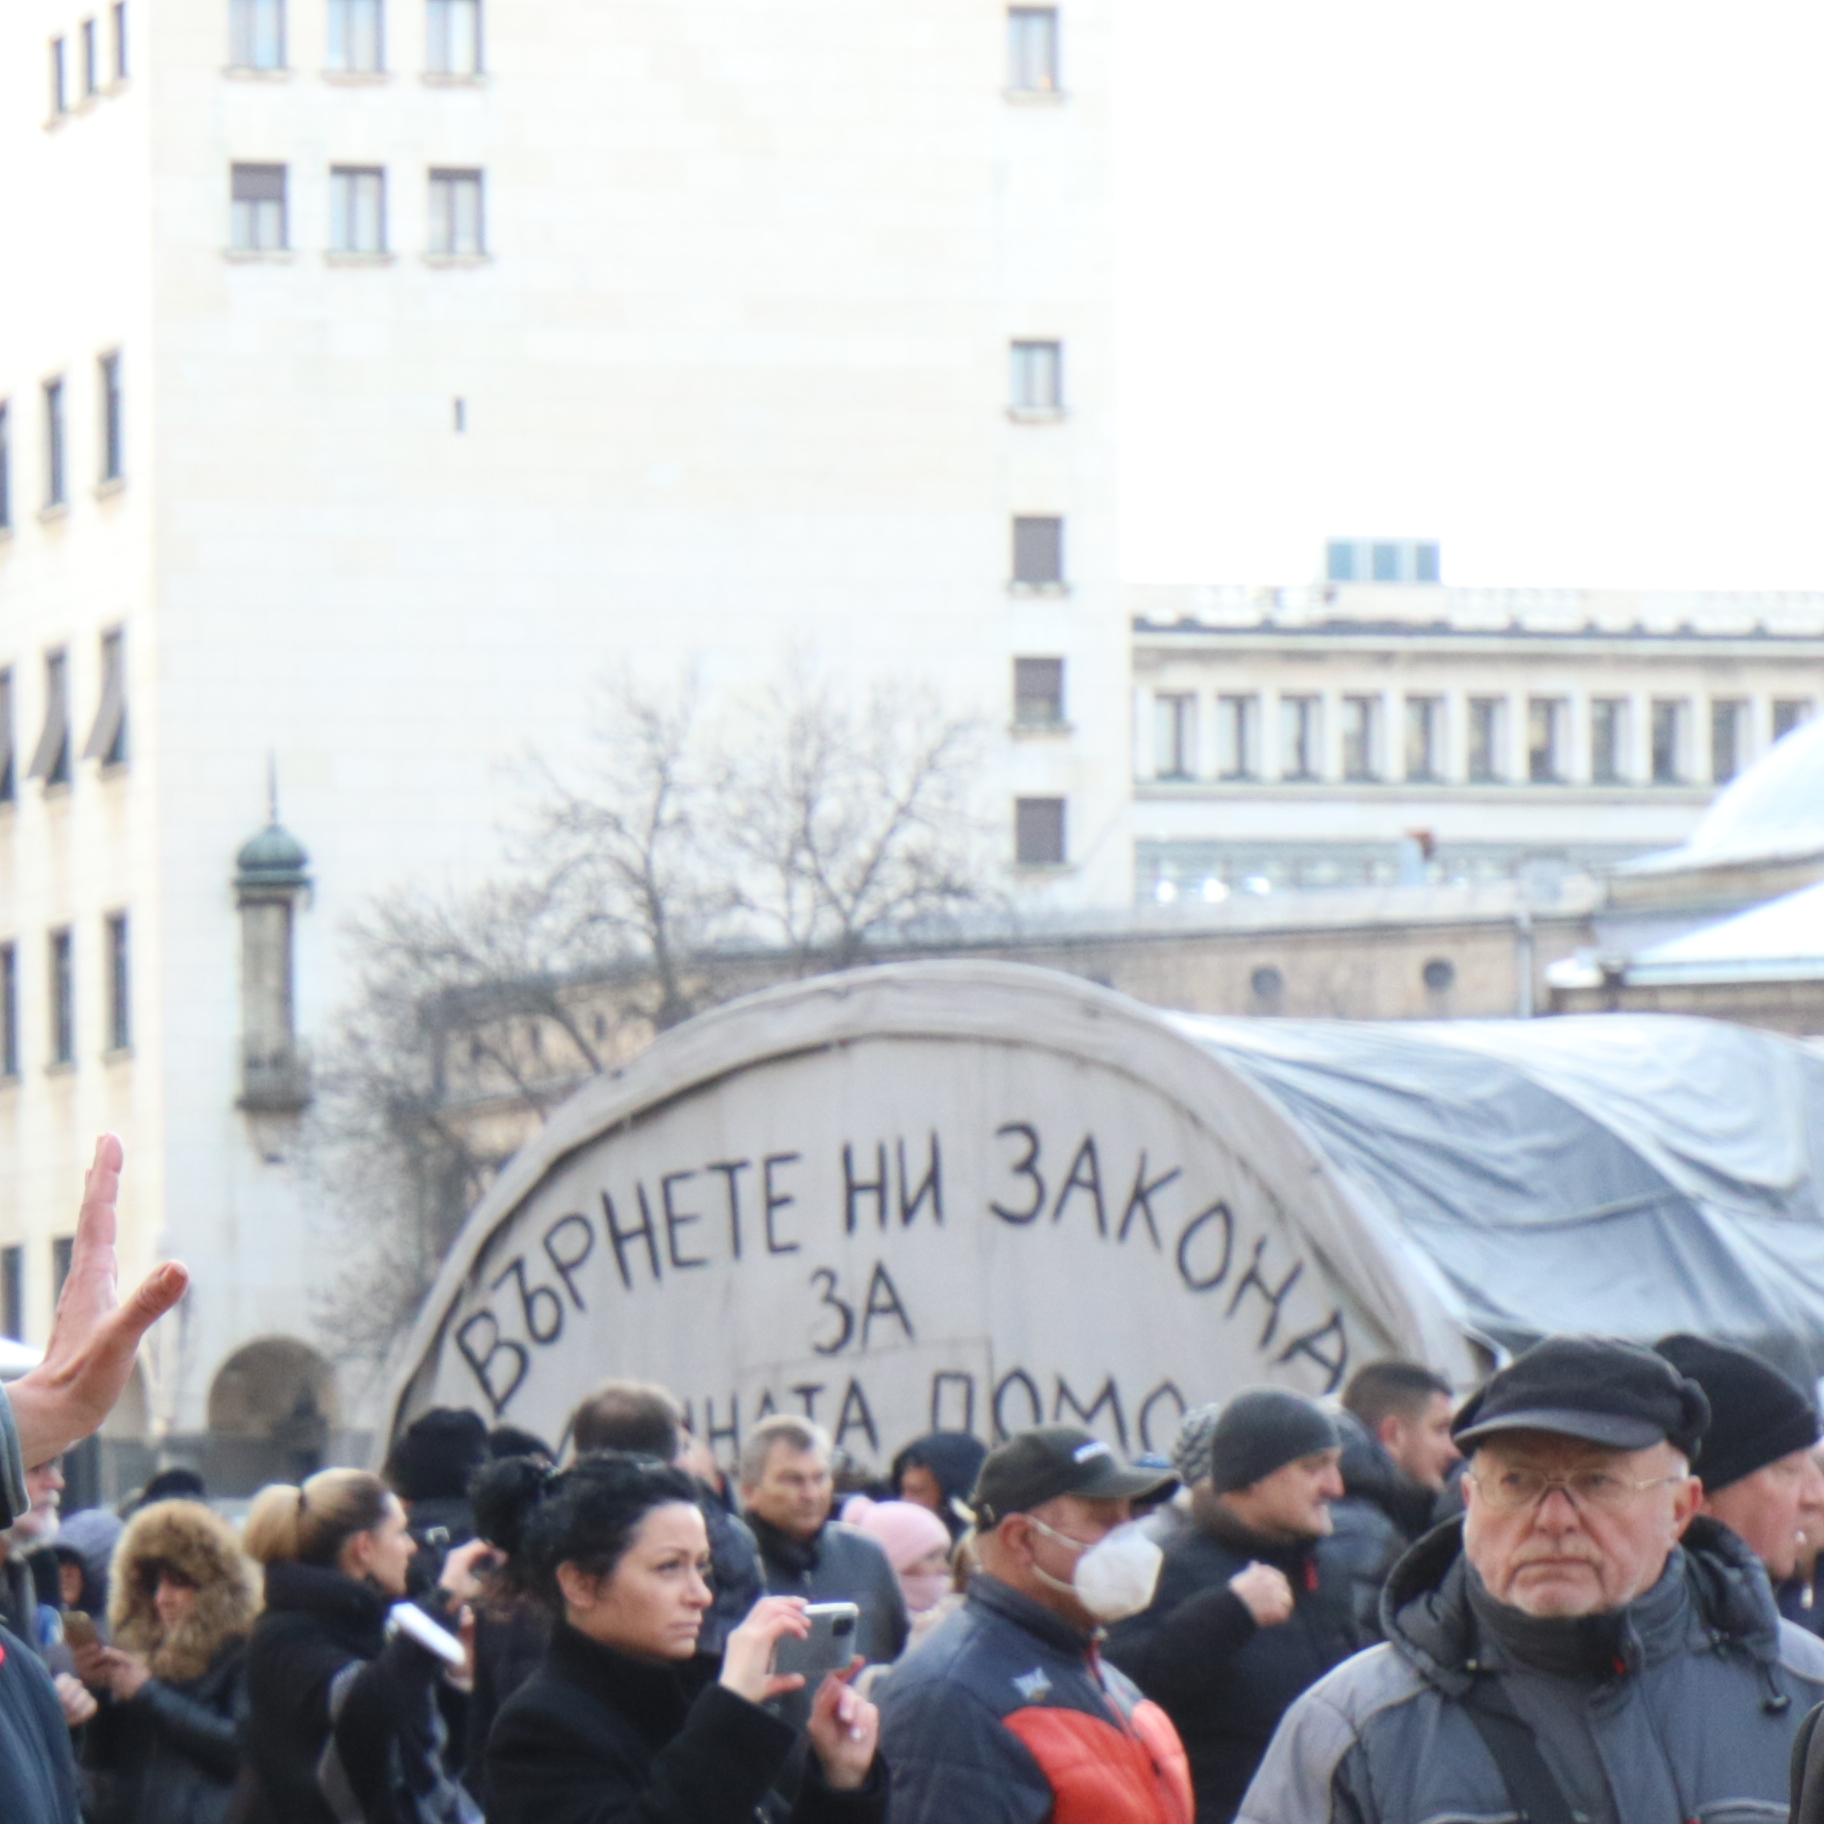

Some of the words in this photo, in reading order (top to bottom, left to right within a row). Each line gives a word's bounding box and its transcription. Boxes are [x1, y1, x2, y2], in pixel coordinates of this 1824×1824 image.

[454, 1151, 802, 1418] ВЪРНЕТЕ
[842, 1126, 944, 1236] НИ
[989, 1121, 1347, 1396] ЗАКОНА
[809, 1260, 915, 1357] ЗА
